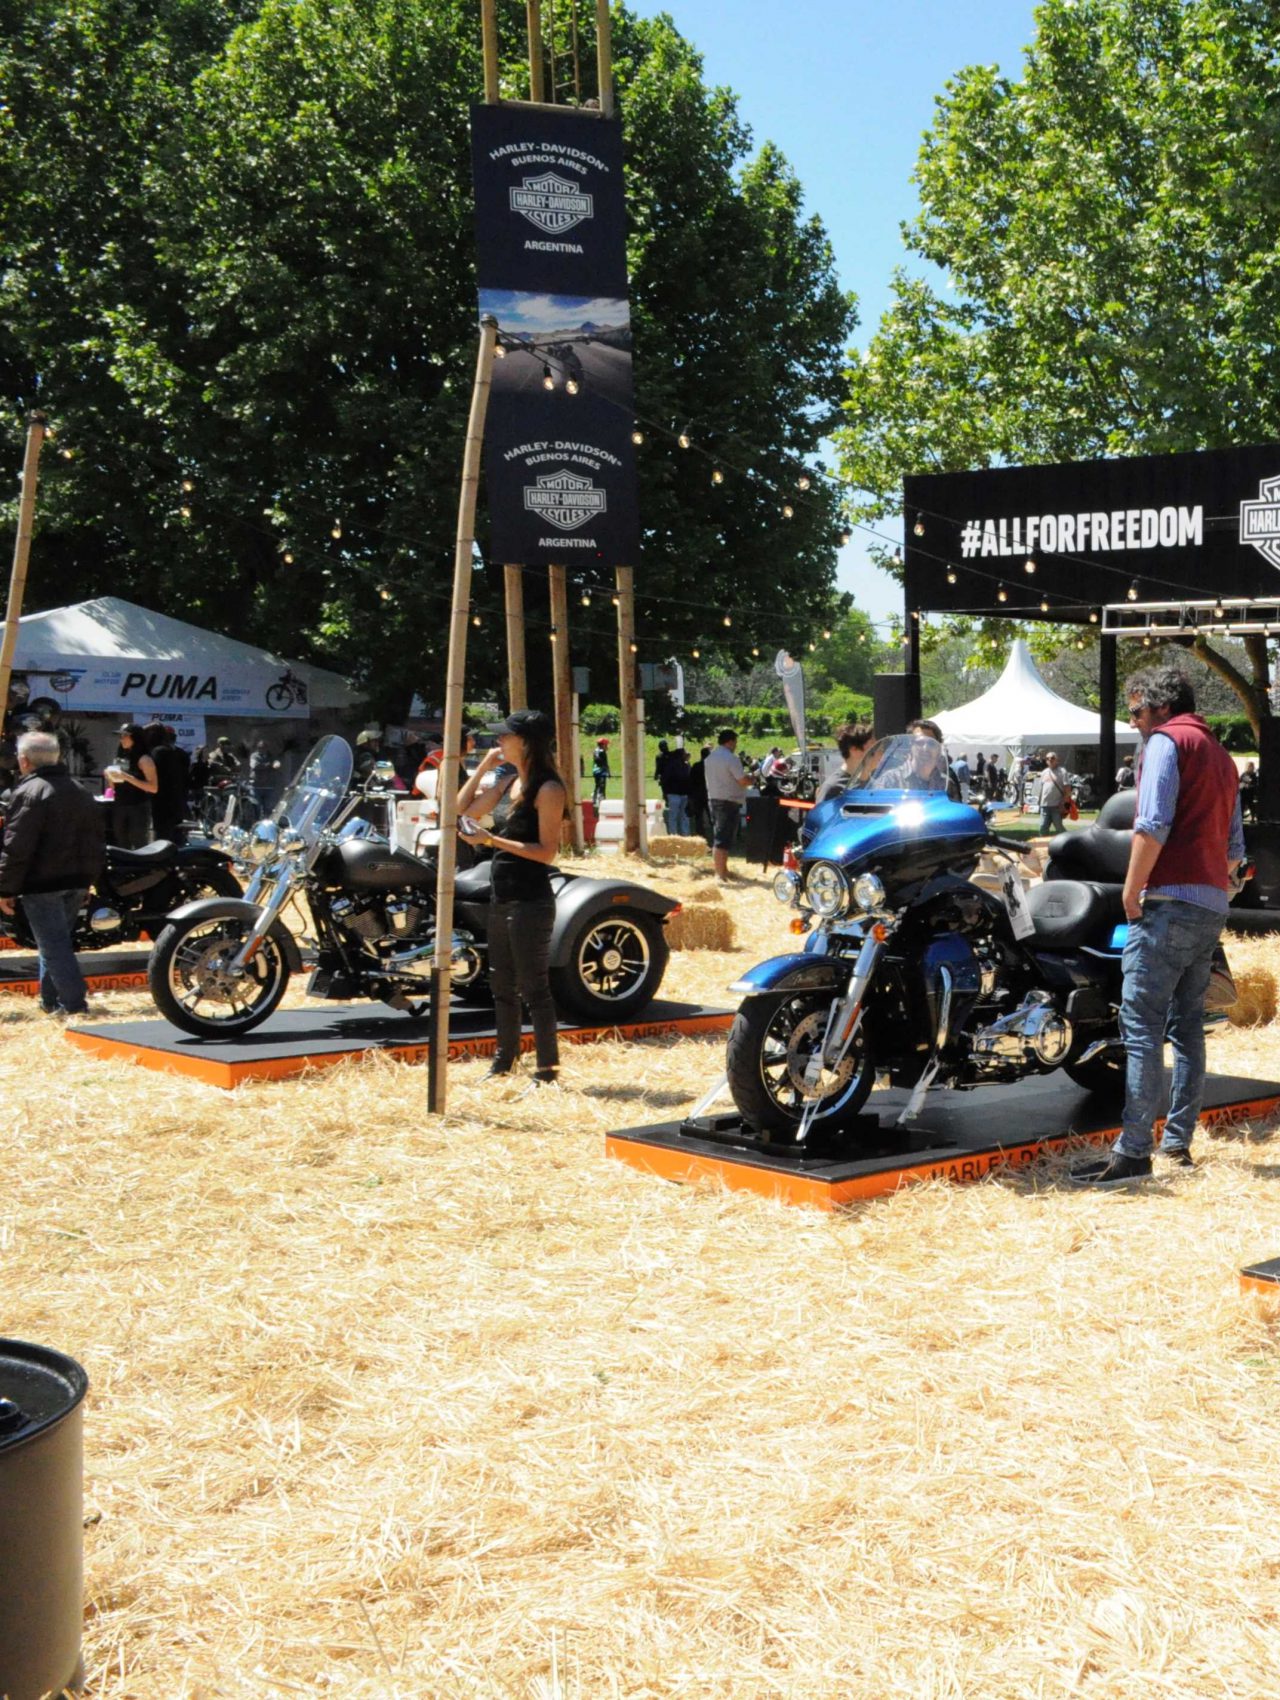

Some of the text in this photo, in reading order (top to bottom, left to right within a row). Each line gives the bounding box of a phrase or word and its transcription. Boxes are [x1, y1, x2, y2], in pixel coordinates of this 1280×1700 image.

[511, 154, 588, 175] BUENOS AIRES
[532, 182, 571, 194] MOTOR
[516, 193, 587, 211] HARLEY-DAVIDSON
[533, 212, 572, 228] CYCLES
[524, 240, 584, 254] ARGENTINA
[525, 453, 602, 471] BUENOS AIRES
[546, 479, 584, 490] MOTOR
[530, 492, 601, 507] HARLEY-DAVIDSON
[546, 509, 585, 524] CYCLES
[960, 505, 1203, 558] #ALLFORFREEDOM
[538, 538, 597, 548] ARGENTINA
[121, 672, 218, 700] PUMA
